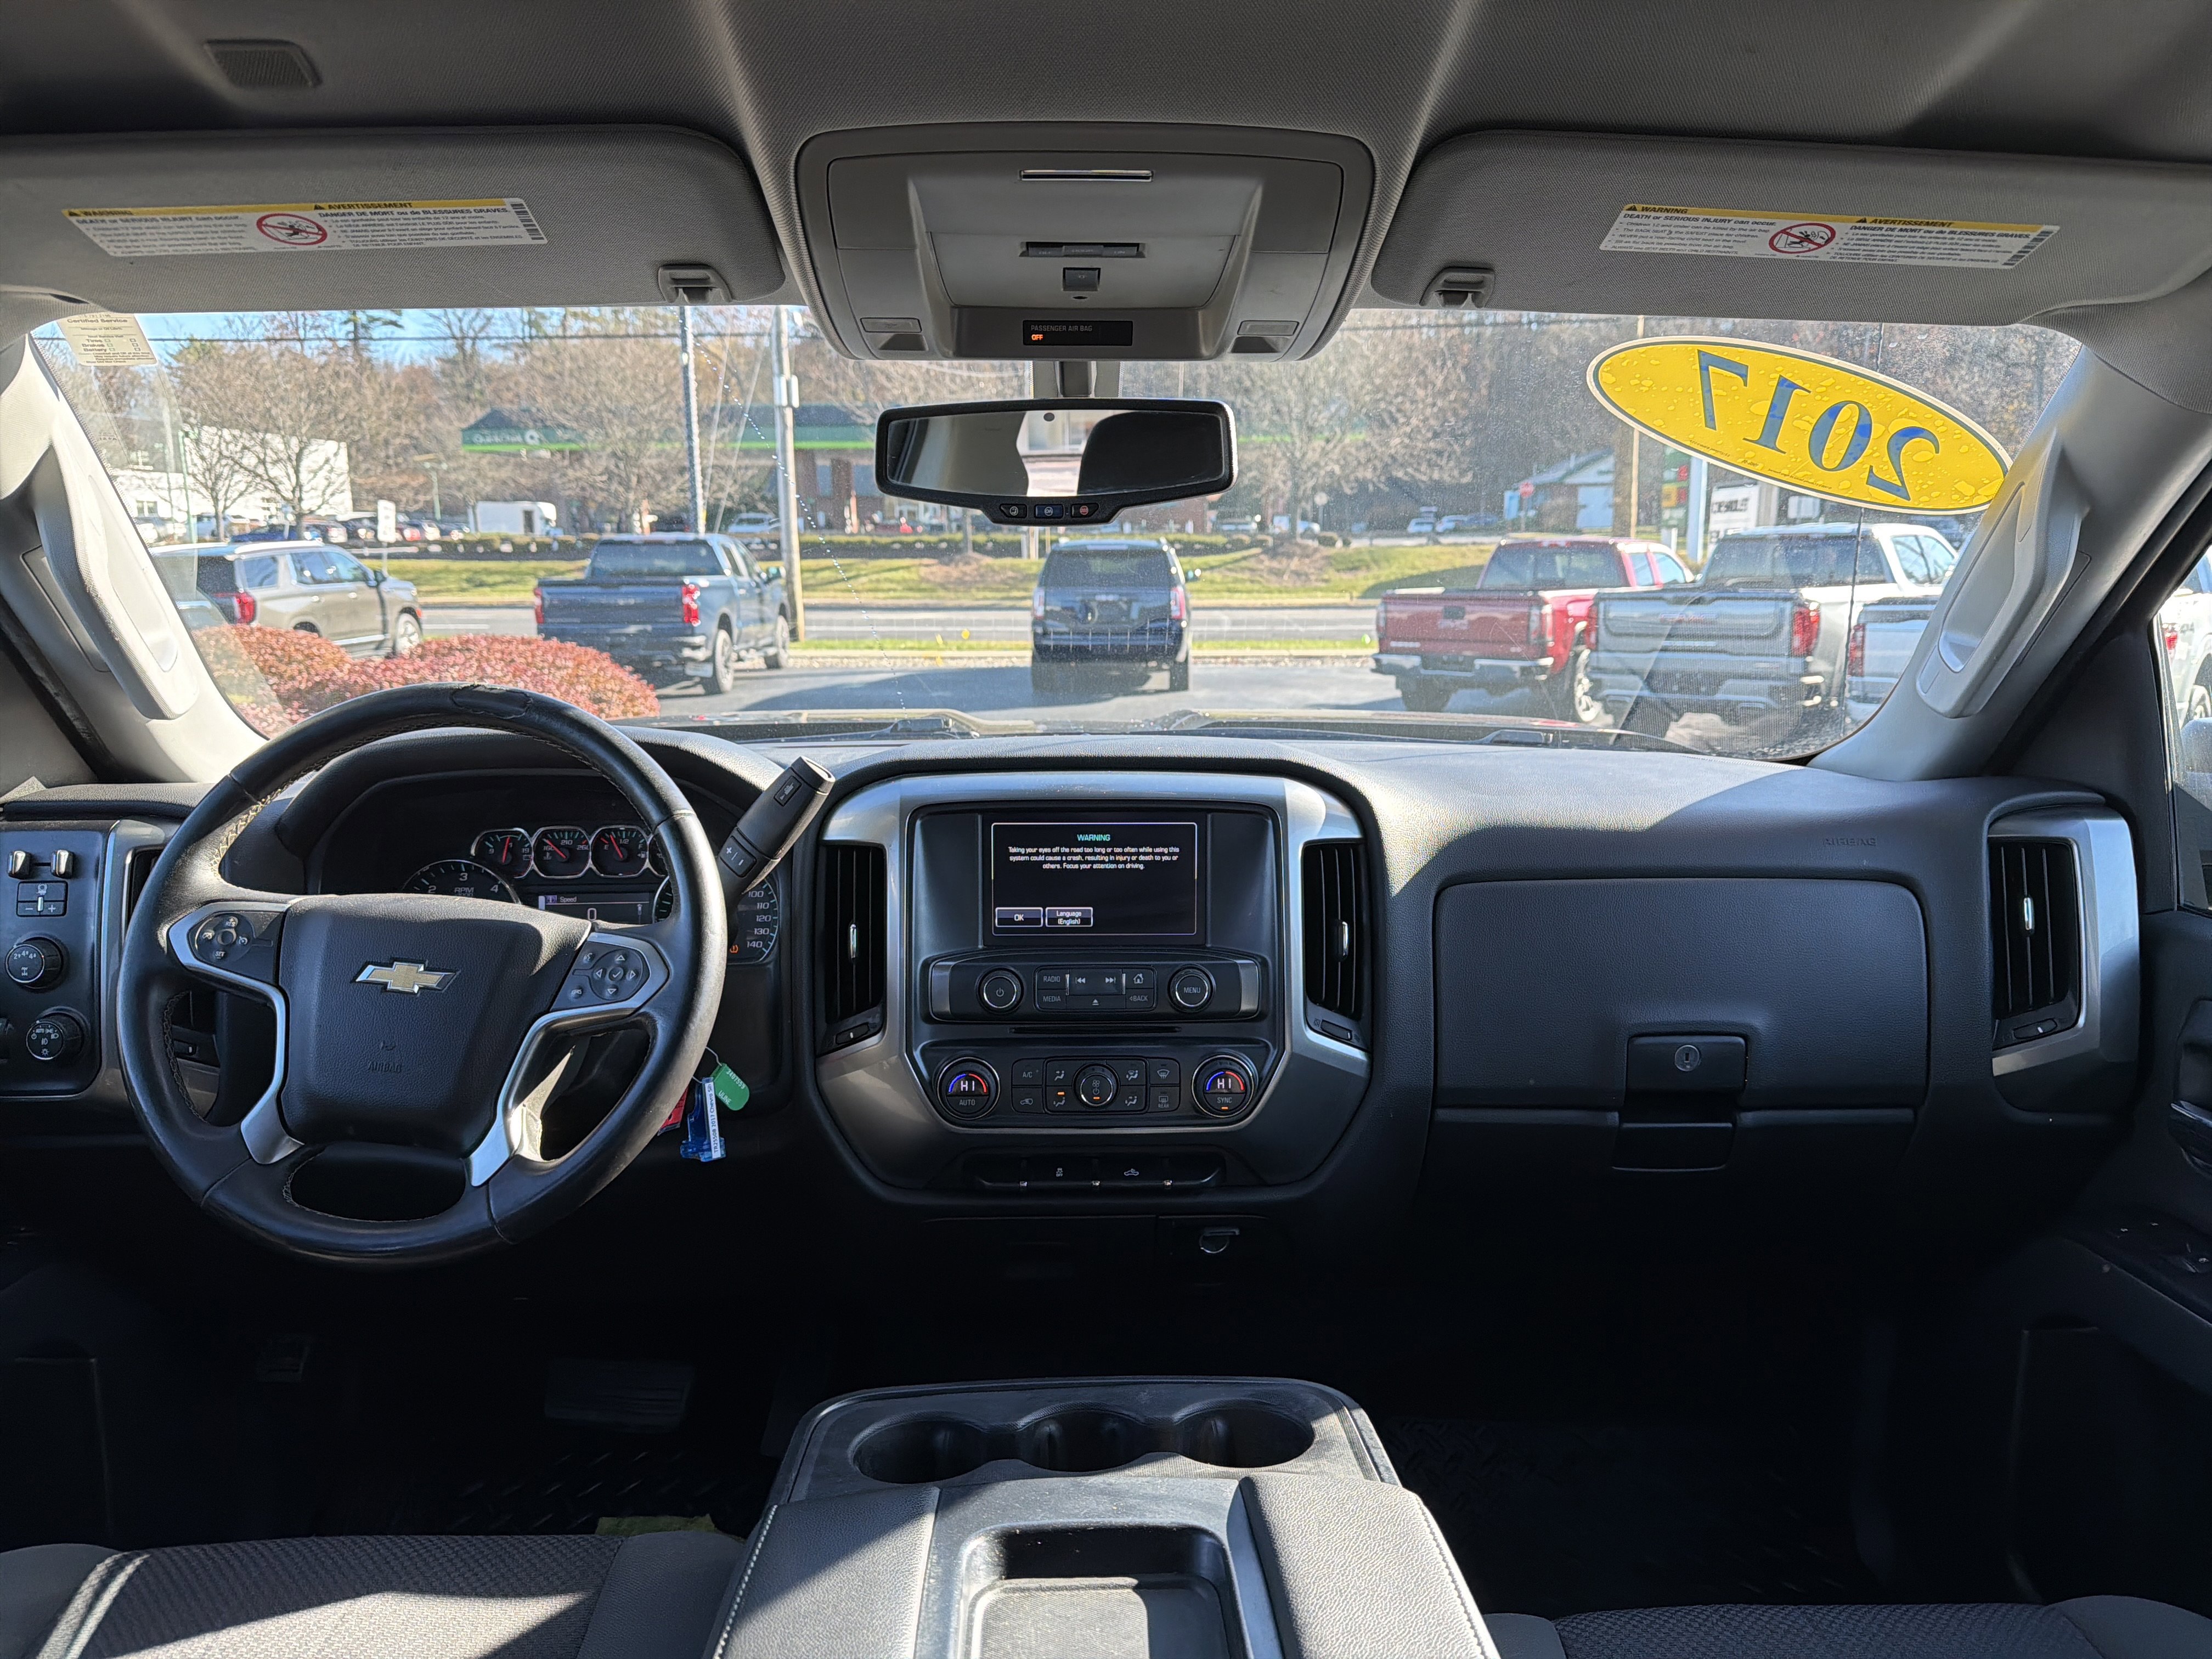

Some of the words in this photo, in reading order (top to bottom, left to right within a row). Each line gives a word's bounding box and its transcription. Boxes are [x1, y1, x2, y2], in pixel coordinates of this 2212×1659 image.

[1641, 206, 1688, 215] WARNING
[1870, 218, 1954, 228] AVERTISSEMENT
[1822, 838, 1876, 846] AIRBAG
[459, 872, 468, 881] 3
[490, 884, 499, 893] 4
[587, 907, 597, 921] 0
[726, 1069, 746, 1090] 3407559
[1217, 1079, 1232, 1090] HI
[960, 1080, 975, 1092] HI
[718, 1090, 732, 1105] ULINE
